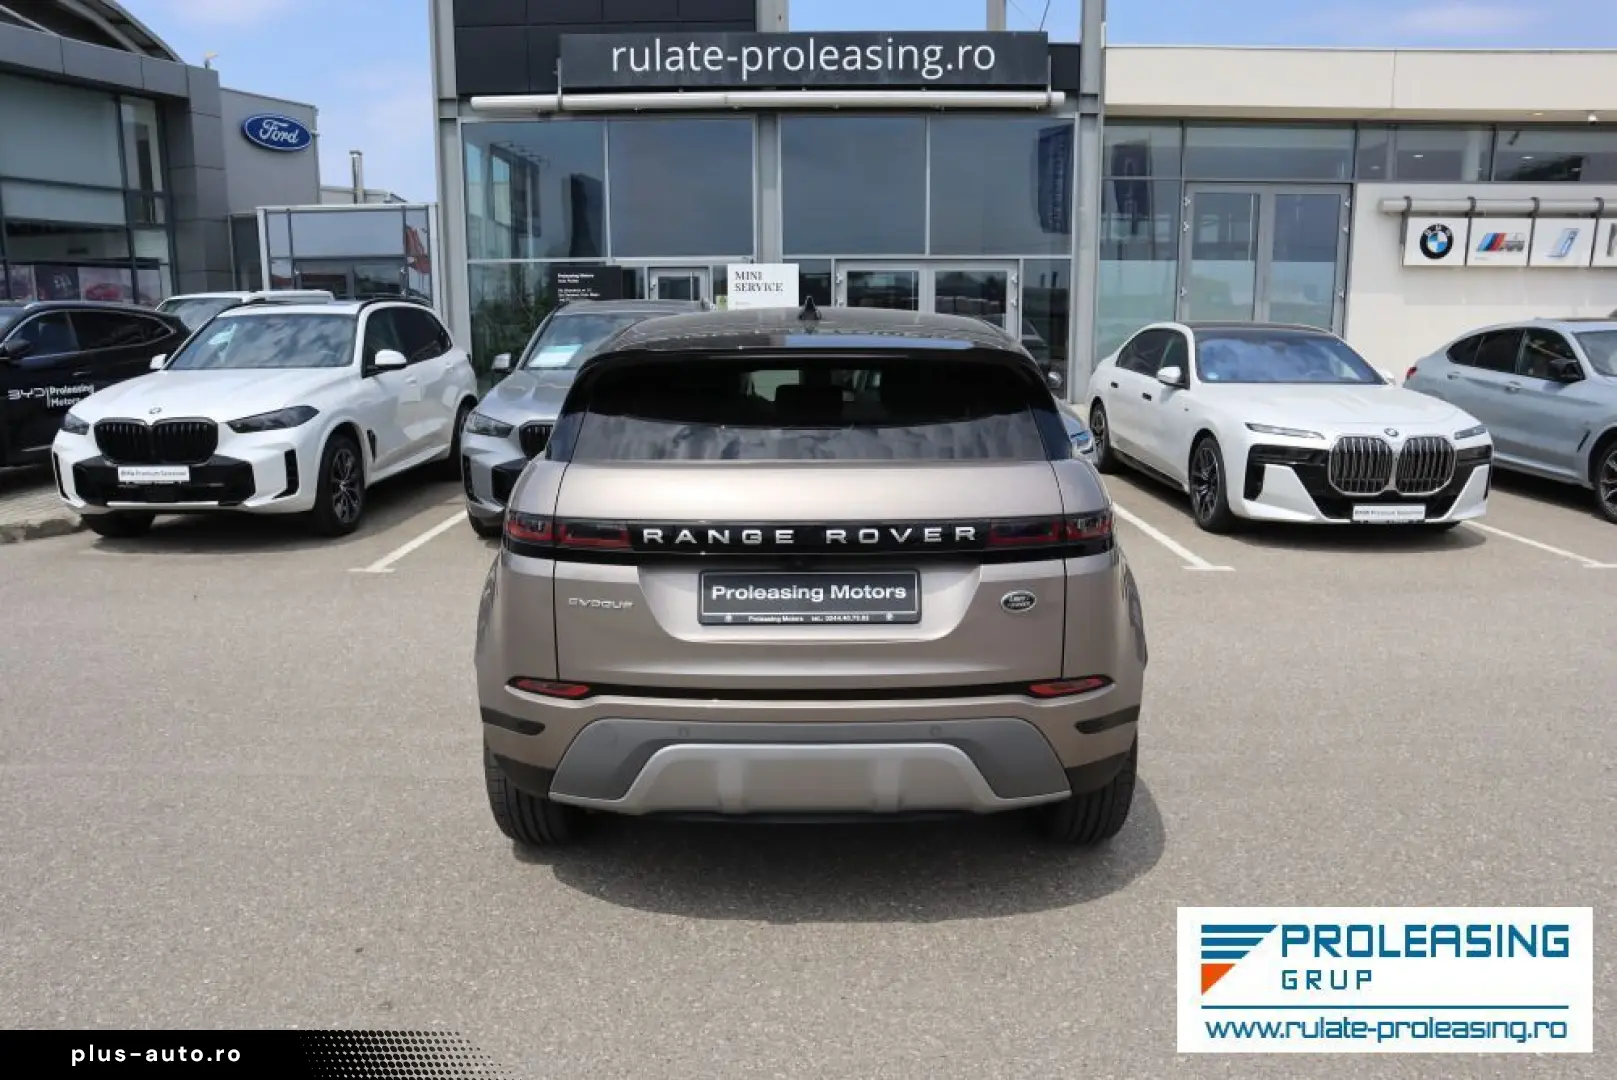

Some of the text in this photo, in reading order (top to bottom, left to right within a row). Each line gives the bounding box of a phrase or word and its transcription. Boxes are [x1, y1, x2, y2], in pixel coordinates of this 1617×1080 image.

[611, 36, 996, 81] rulate-proleasing.ro
[260, 119, 299, 144] Ford
[735, 271, 763, 281] MINI
[734, 282, 784, 292] SERVICE
[643, 526, 976, 544] RANGE ROVER
[711, 584, 907, 602] Proleasing Motors
